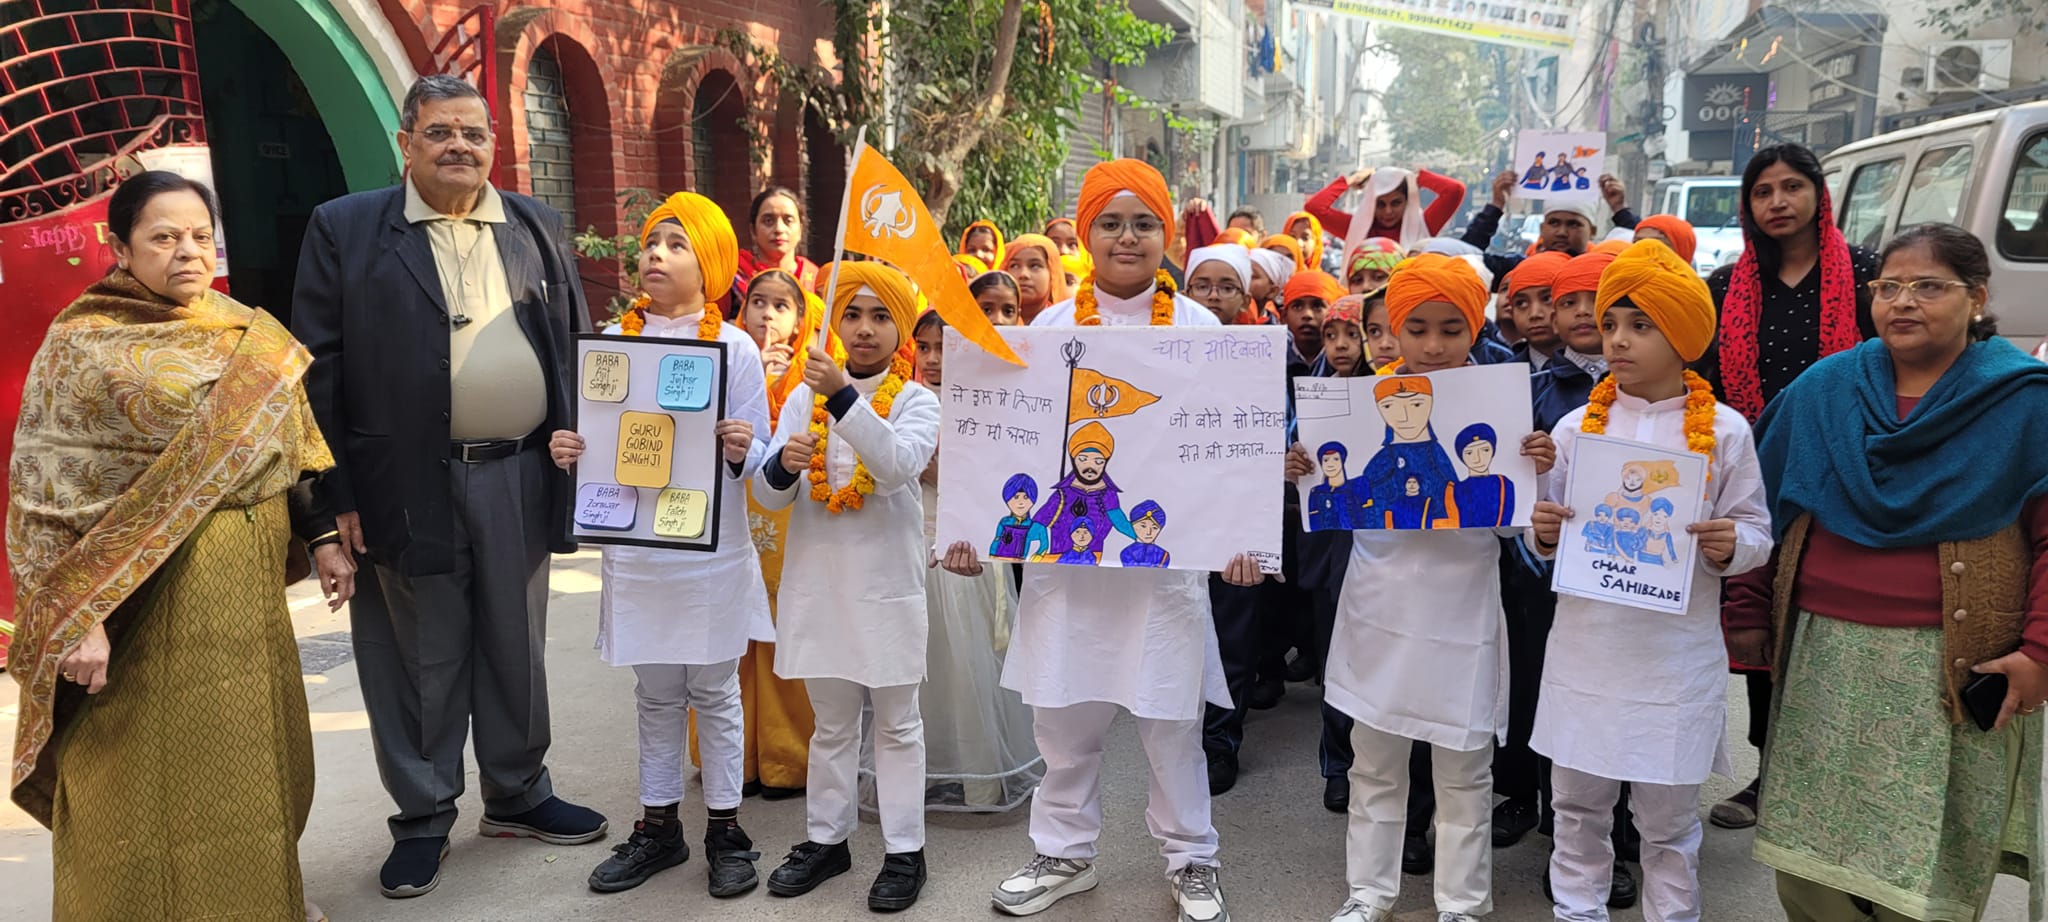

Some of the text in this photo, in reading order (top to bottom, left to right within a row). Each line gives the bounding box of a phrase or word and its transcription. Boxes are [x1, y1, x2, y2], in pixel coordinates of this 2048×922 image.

[1153, 338, 1194, 364] चार
[595, 354, 619, 366] BABA
[673, 359, 695, 371] BABA
[1169, 406, 1190, 428] जो
[1195, 407, 1222, 429] बोले
[1233, 406, 1248, 429] सो
[630, 422, 662, 436] GURU
[626, 438, 664, 452] GOBIND
[596, 487, 620, 498] BABA
[670, 492, 691, 504] BABA
[586, 499, 620, 510] Zorawar
[1592, 560, 1637, 575] CHAAR
[1600, 574, 1681, 602] SAHIBZADE
